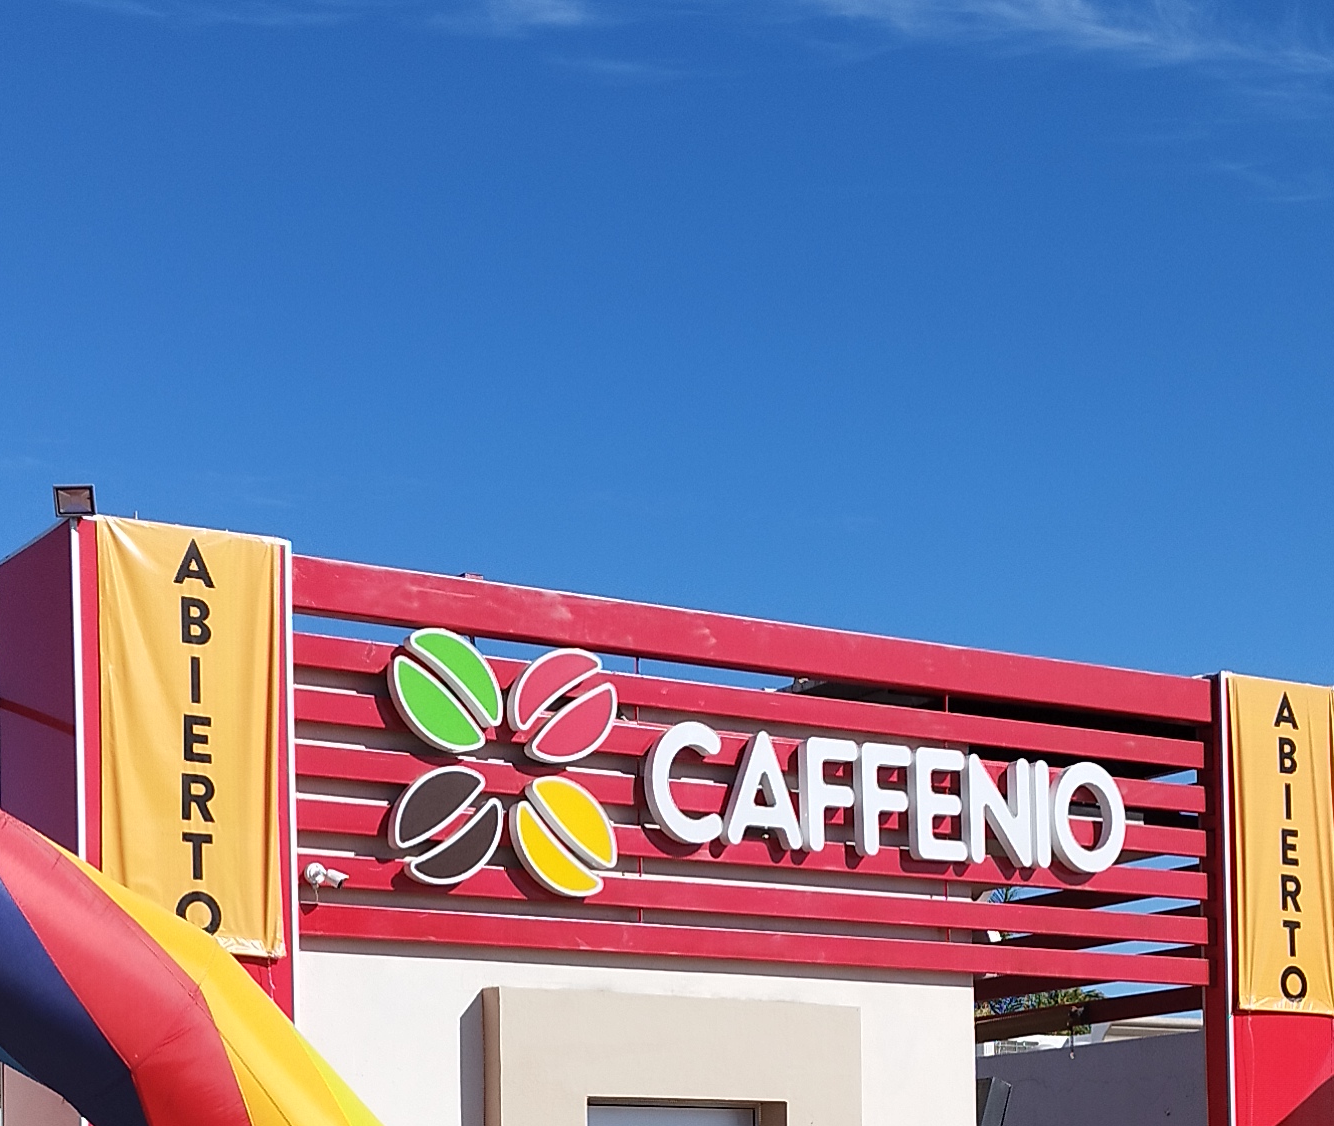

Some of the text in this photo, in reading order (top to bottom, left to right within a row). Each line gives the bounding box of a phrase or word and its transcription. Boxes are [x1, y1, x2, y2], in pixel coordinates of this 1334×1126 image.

[171, 537, 223, 936] ABIERTO
[644, 720, 1126, 874] CAFFENIO
[1275, 690, 1312, 1006] ABIERTO
